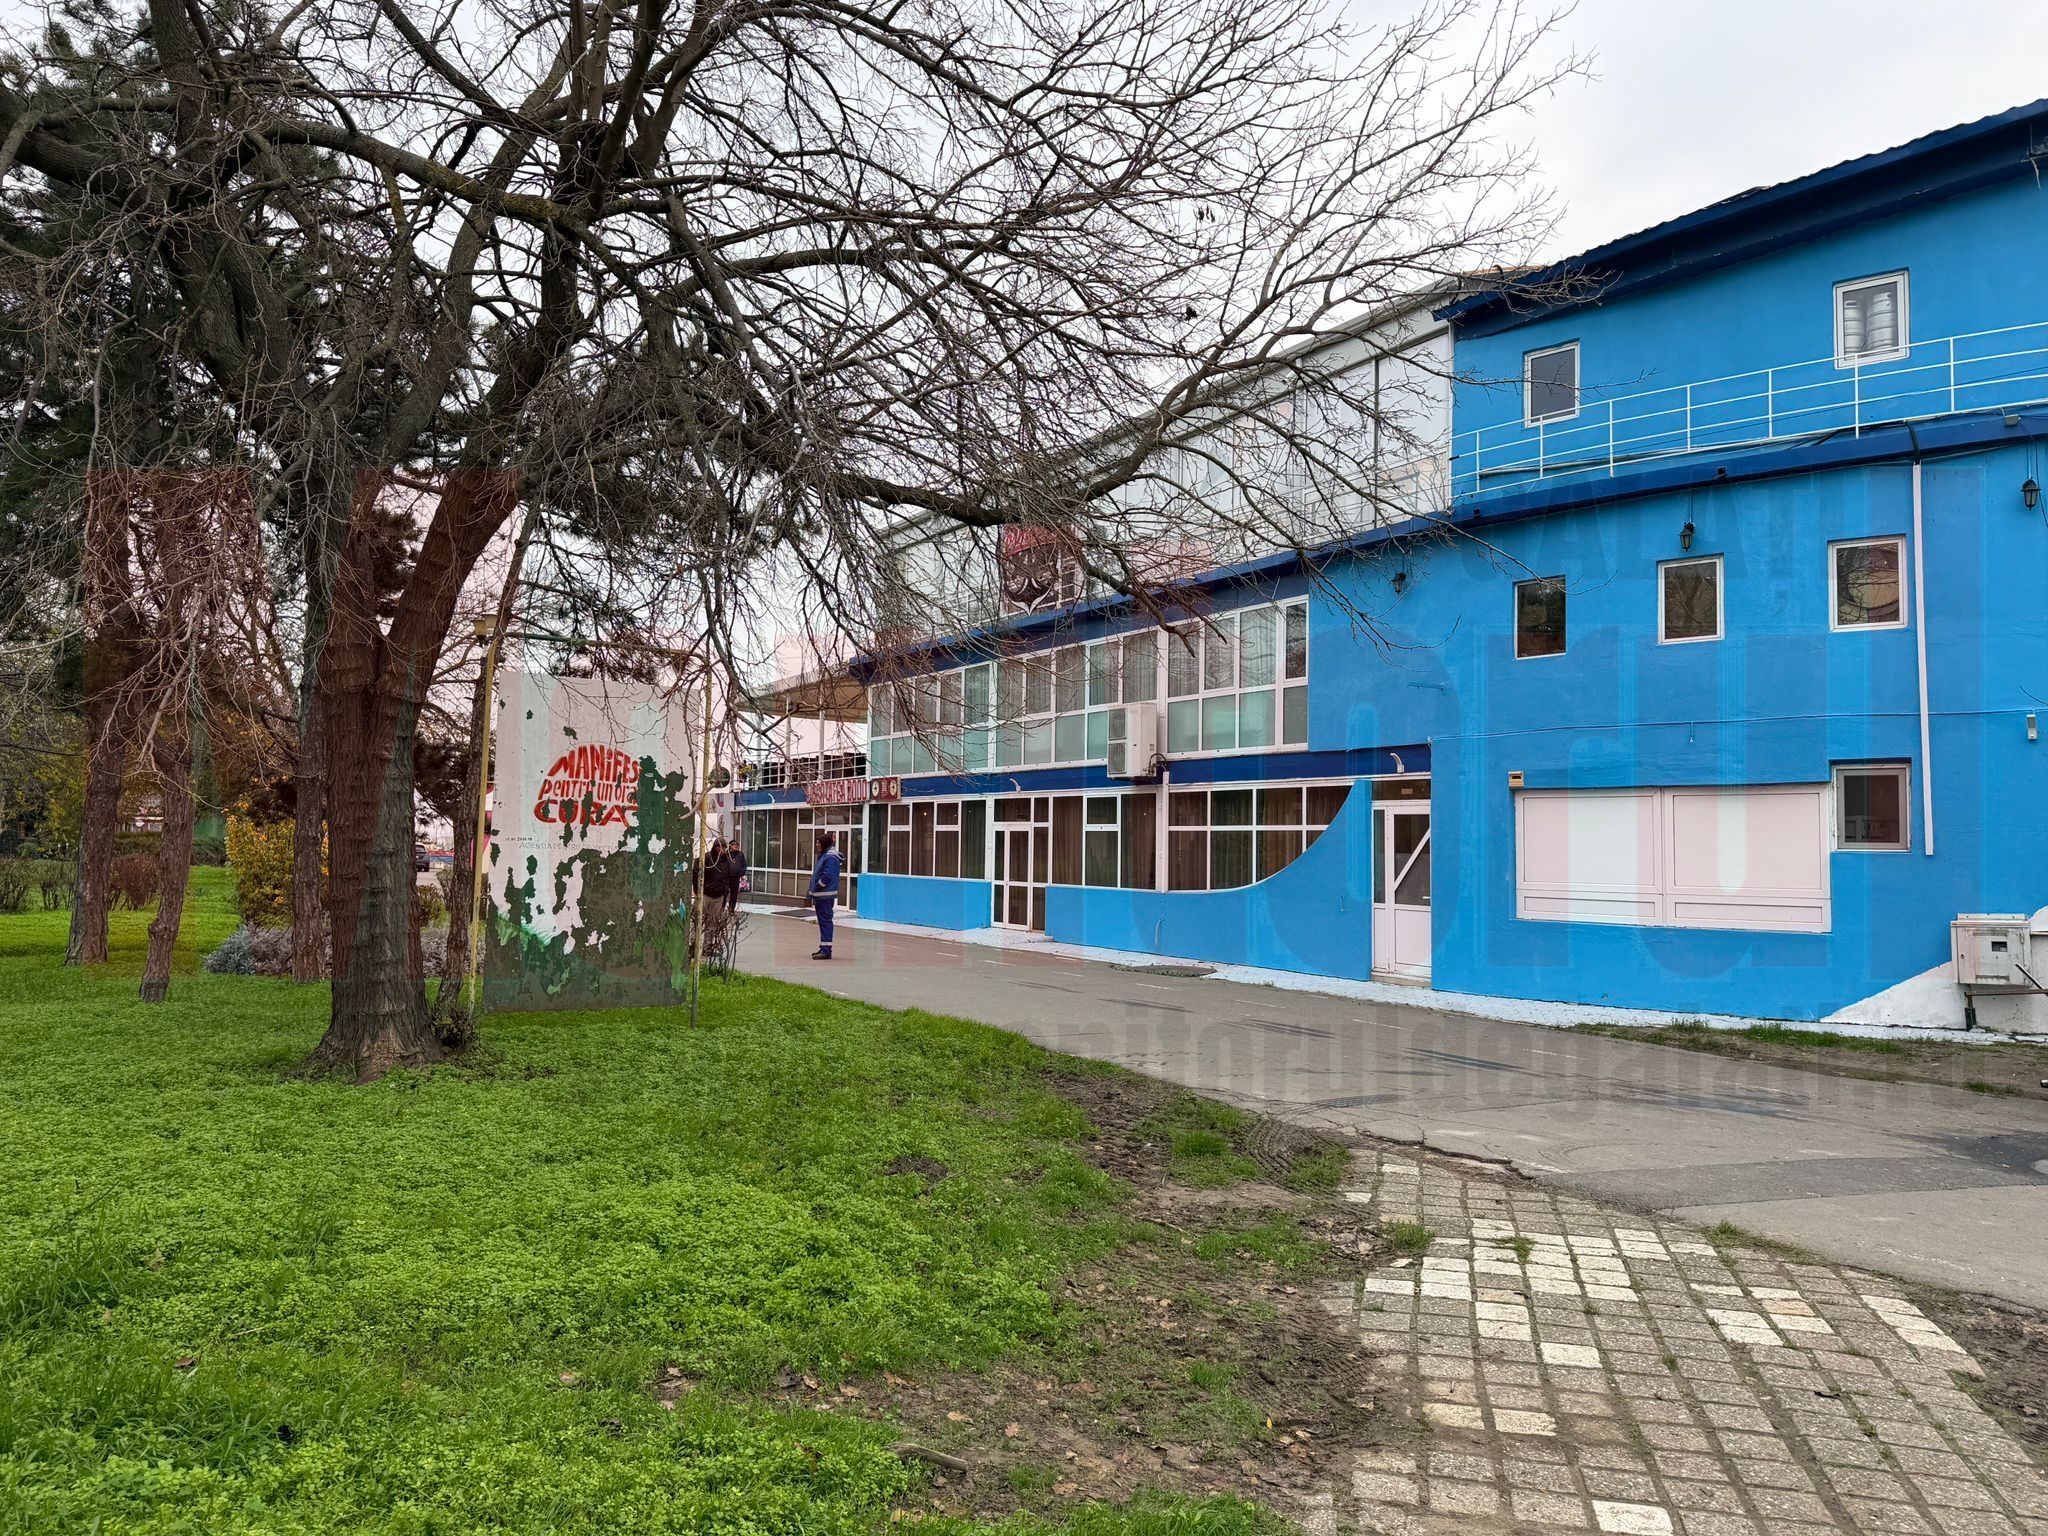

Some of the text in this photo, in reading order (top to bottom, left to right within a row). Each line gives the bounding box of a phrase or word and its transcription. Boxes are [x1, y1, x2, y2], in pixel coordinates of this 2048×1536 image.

[547, 744, 643, 784] MANIFES
[597, 781, 614, 803] un
[614, 784, 639, 805] ora
[847, 778, 868, 801] 2000
